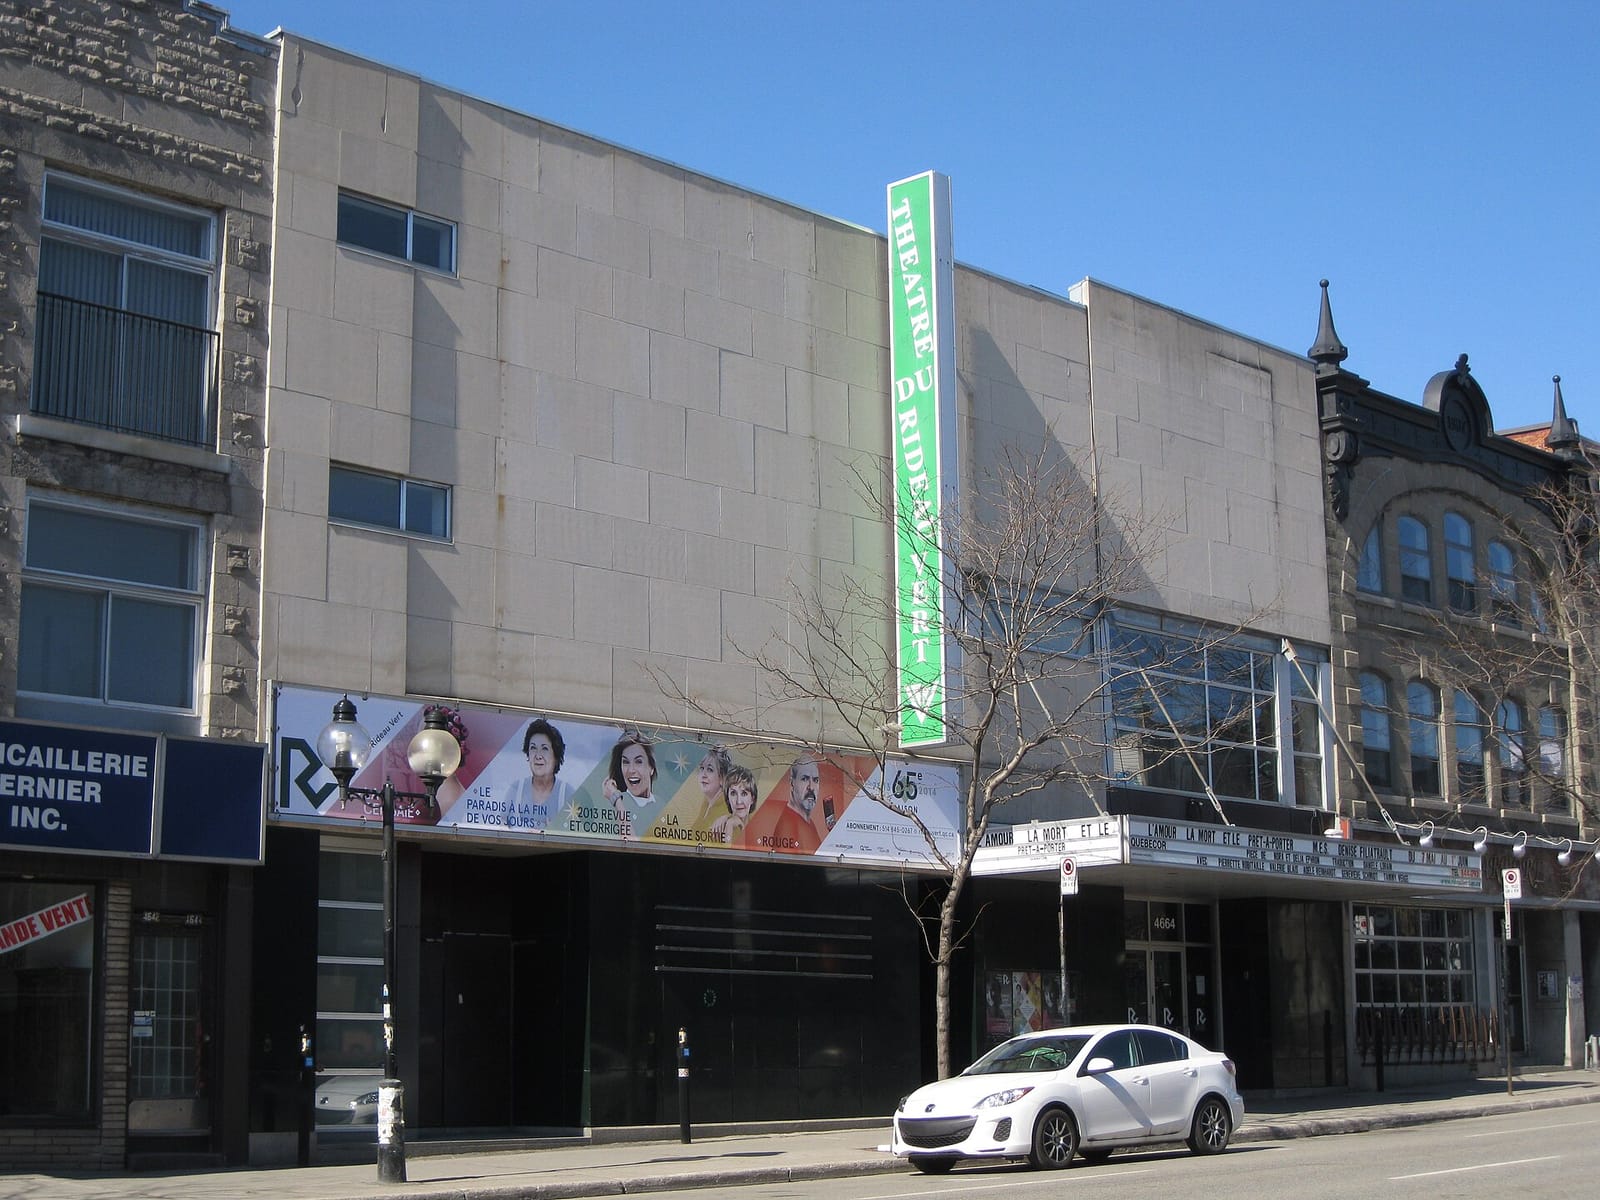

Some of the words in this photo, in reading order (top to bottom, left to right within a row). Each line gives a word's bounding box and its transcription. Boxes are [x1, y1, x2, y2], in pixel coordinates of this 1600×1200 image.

[892, 197, 935, 359] THEATRE
[895, 365, 935, 403] DU
[898, 405, 938, 541] RIDEAU
[909, 551, 933, 662] VERT
[370, 726, 391, 749] Rideau
[389, 711, 404, 728] Vert
[479, 787, 491, 798] LE
[466, 800, 507, 812] PARADIS
[508, 799, 516, 814] À
[518, 803, 531, 814] LA
[533, 805, 547, 816] FIN
[578, 806, 598, 819] 2013
[601, 809, 631, 822] REVUE
[11, 805, 68, 831] INC.
[466, 813, 479, 824] DE
[481, 815, 501, 826] VOS
[504, 816, 535, 828] JOURS
[667, 814, 679, 826] LA
[569, 821, 581, 832] ET
[583, 821, 631, 836] CORRIGÉE
[654, 826, 693, 841] GRANDE
[695, 829, 726, 844] SORTIE
[1027, 830, 1039, 843] LA
[1043, 827, 1067, 842] MORT
[1081, 824, 1093, 838] ET
[1098, 822, 1110, 836] LE
[1148, 824, 1177, 840] L'AMOUR
[1186, 827, 1195, 841] LA
[1198, 829, 1216, 844] MORT
[762, 836, 795, 849] ROUGE
[1130, 838, 1167, 850] QUEBECOR
[1154, 917, 1176, 930] 4664
